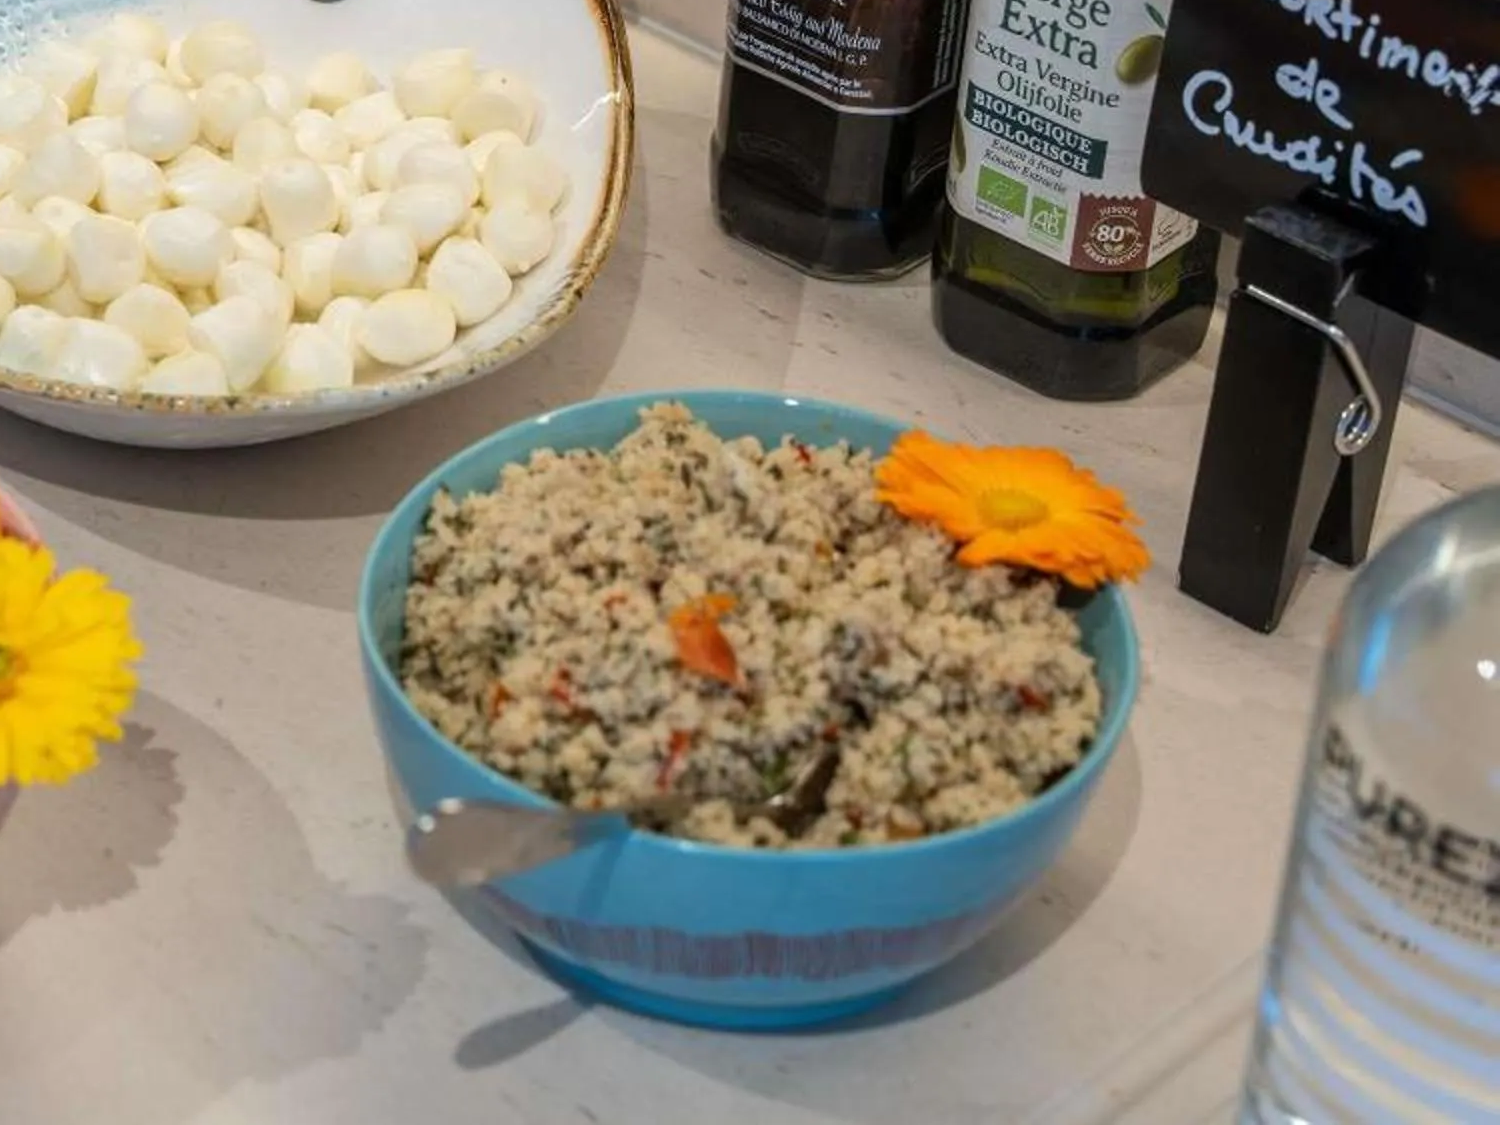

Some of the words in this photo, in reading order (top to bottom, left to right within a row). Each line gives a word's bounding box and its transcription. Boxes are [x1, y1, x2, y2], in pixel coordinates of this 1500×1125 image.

[974, 30, 1028, 74] Extra
[1034, 57, 1121, 109] Vergine
[997, 70, 1083, 124] Olijfolie
[1275, 57, 1355, 131] de
[971, 109, 1090, 174] BIOLOGISCH
[973, 87, 1093, 156] BIOLOGIQUE
